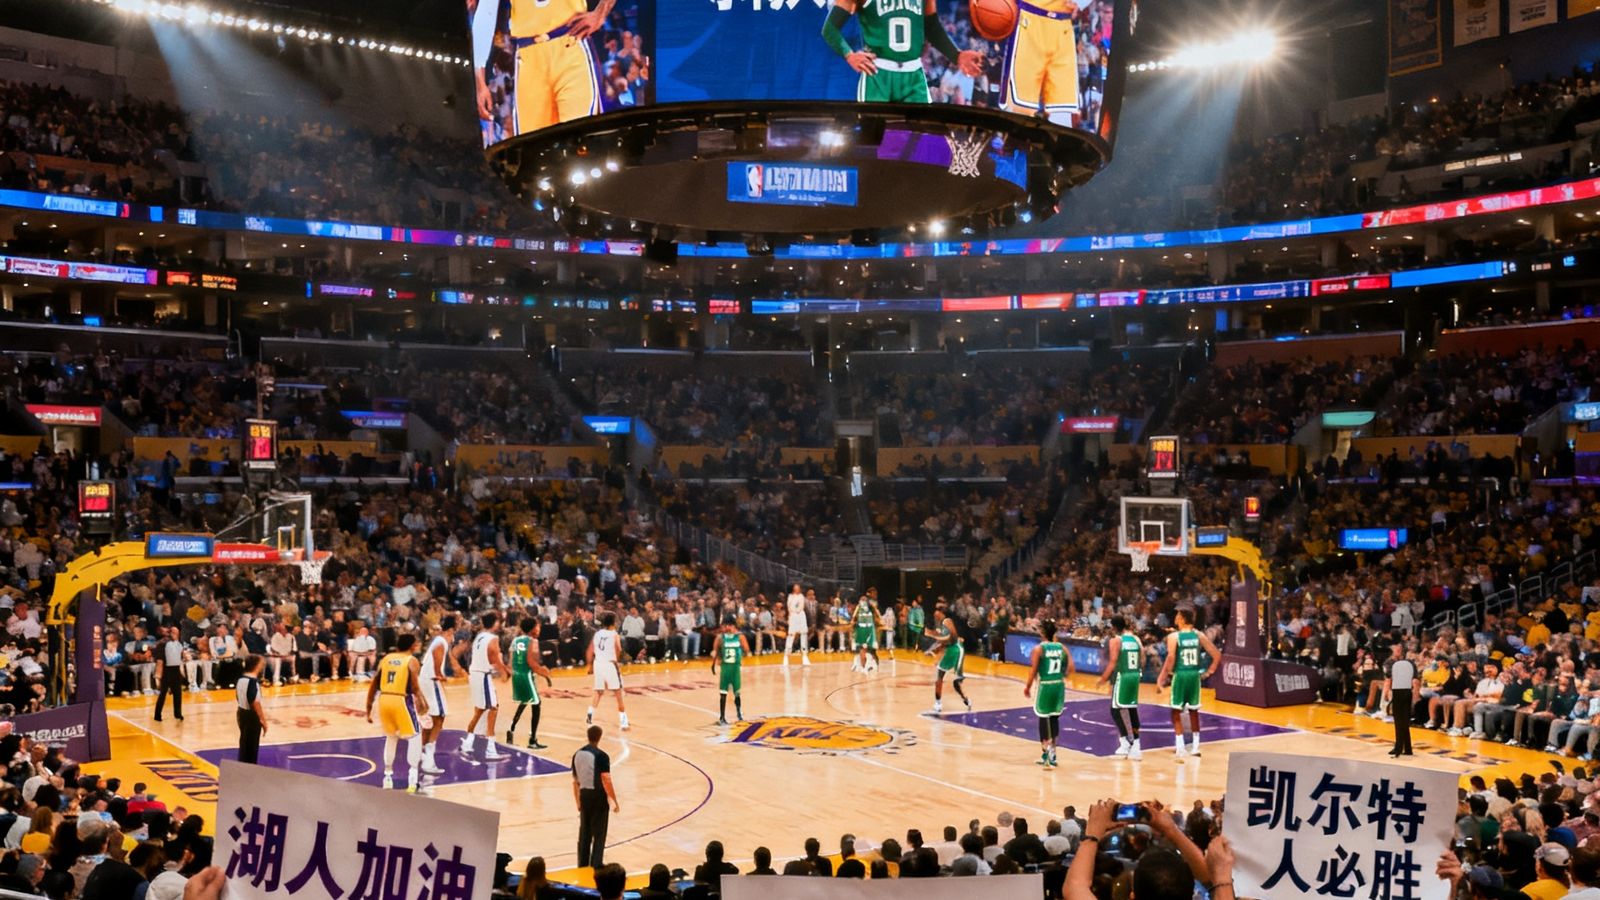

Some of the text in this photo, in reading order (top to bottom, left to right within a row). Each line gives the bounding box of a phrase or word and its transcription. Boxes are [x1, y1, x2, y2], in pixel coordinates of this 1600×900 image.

[888, 17, 912, 52] 0
[1247, 765, 1427, 843] 凯尔特
[225, 806, 477, 900] 湖人加油
[1261, 838, 1422, 900] 人必胜
